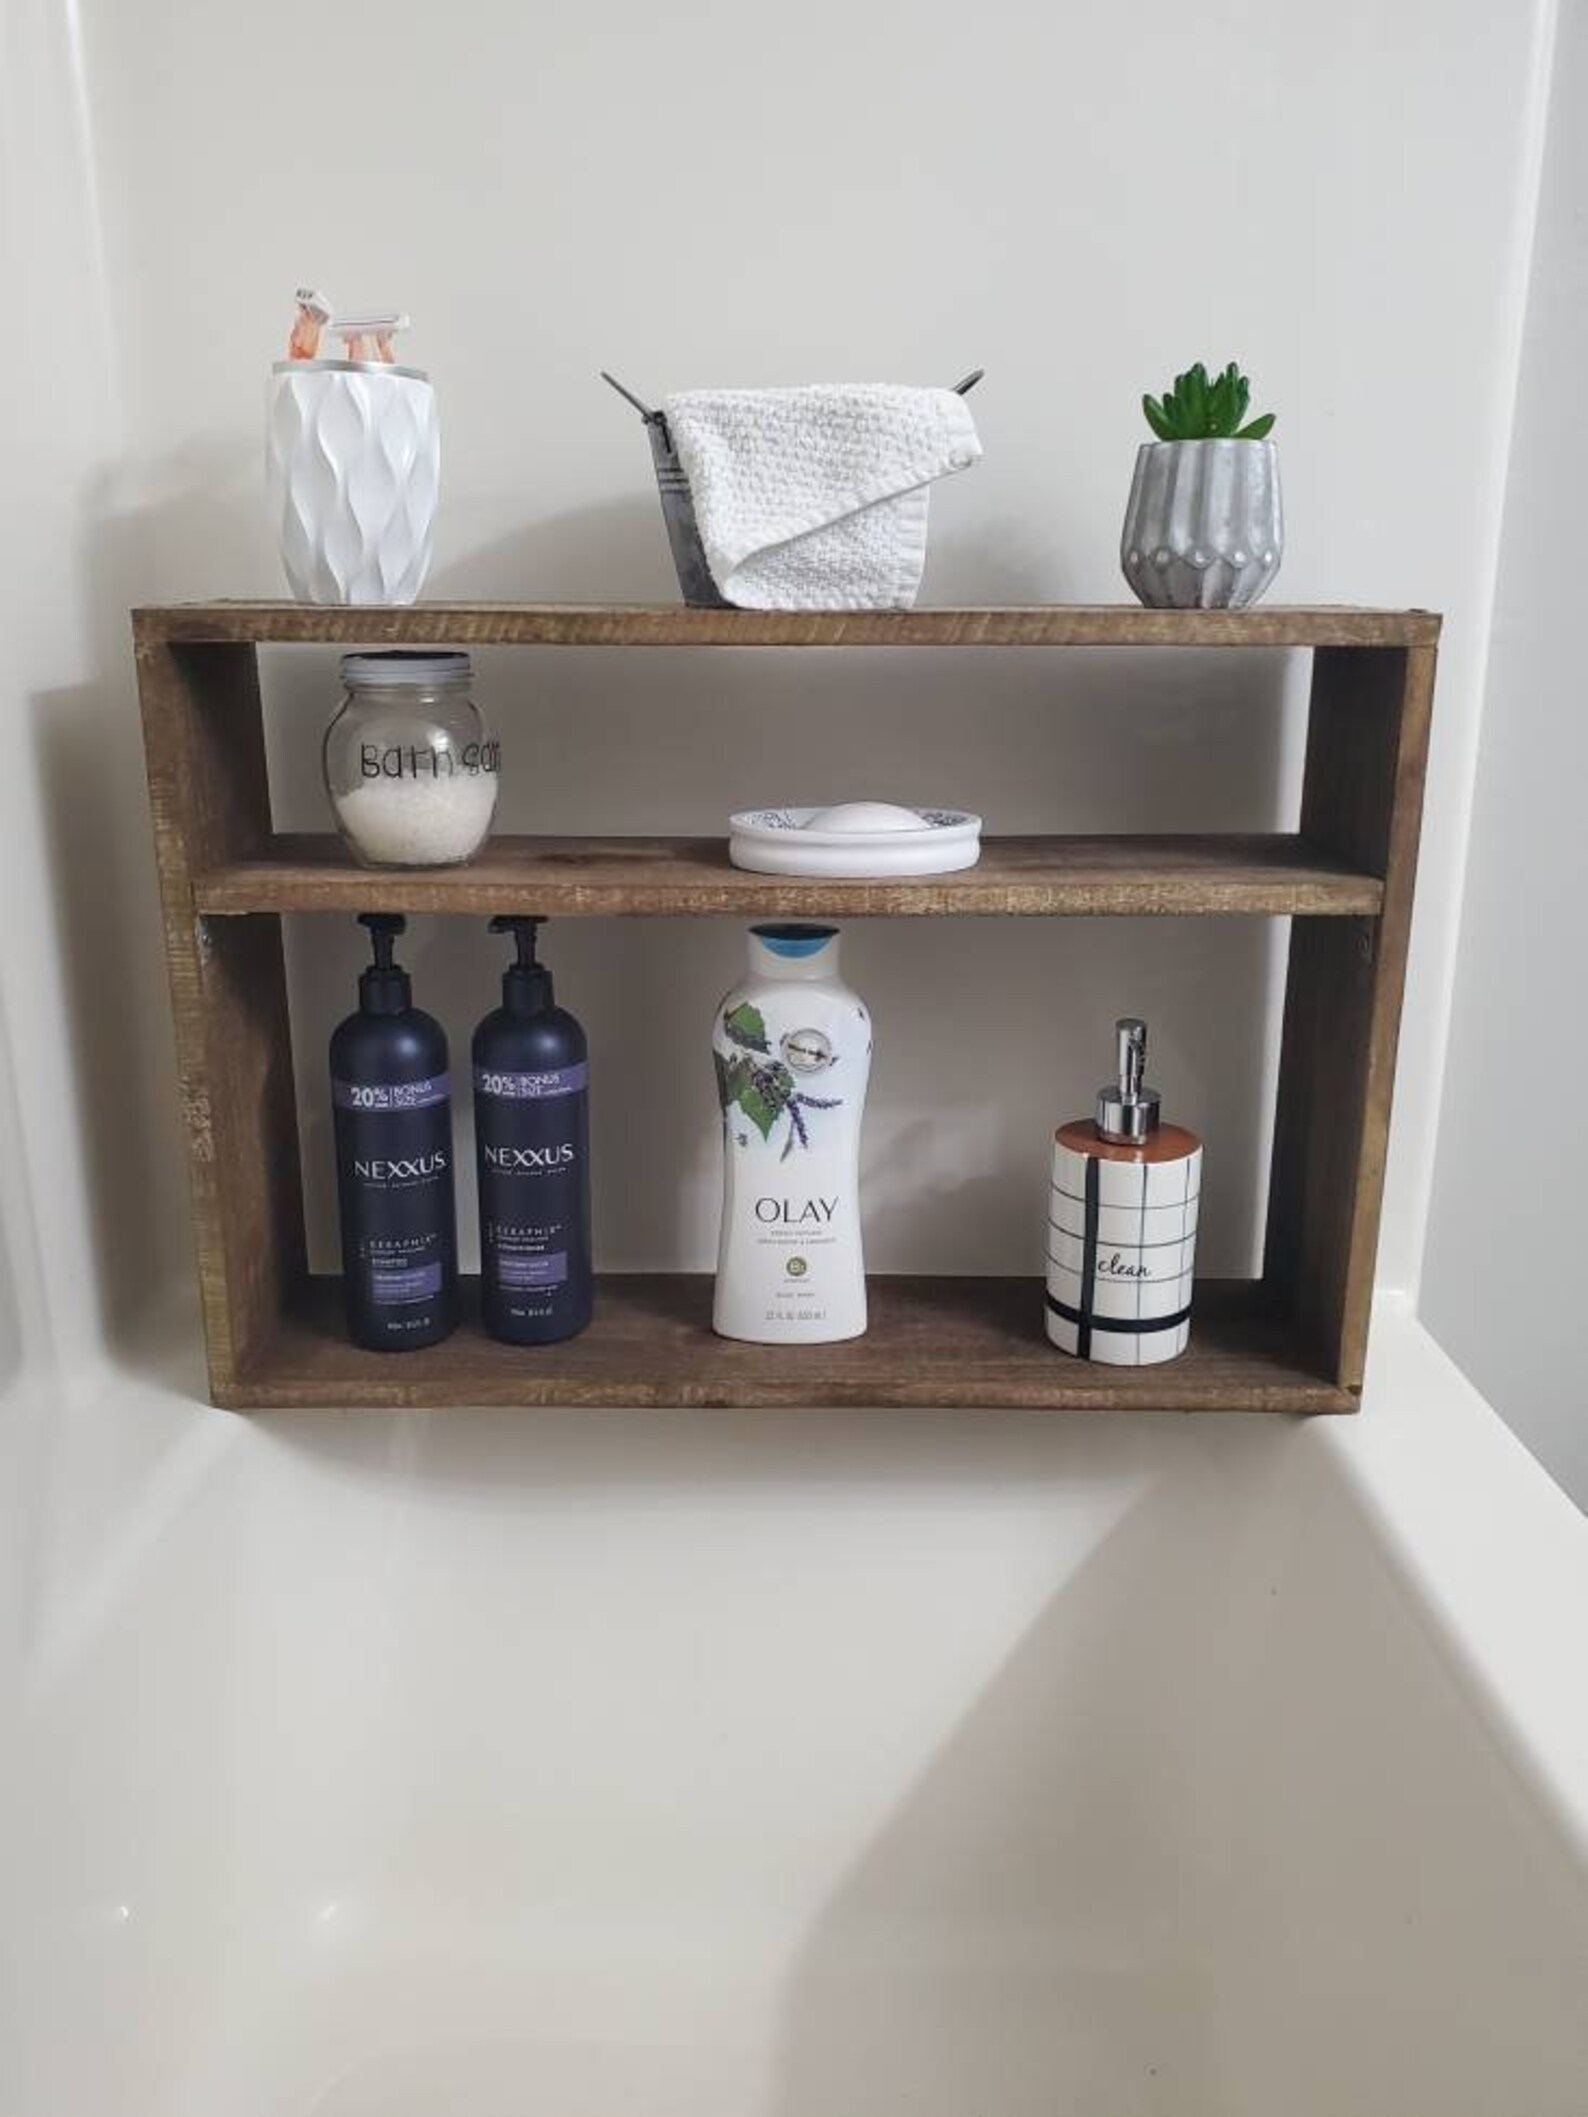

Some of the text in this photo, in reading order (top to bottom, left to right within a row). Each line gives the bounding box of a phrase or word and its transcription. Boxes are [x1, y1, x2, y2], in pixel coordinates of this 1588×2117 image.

[482, 1073, 516, 1095] 20%
[350, 1086, 389, 1108] 20%
[354, 1152, 446, 1180] NEXXUS
[484, 1143, 574, 1167] NEXXUS
[755, 1196, 839, 1223] OLAY
[1098, 1252, 1152, 1277] clean
